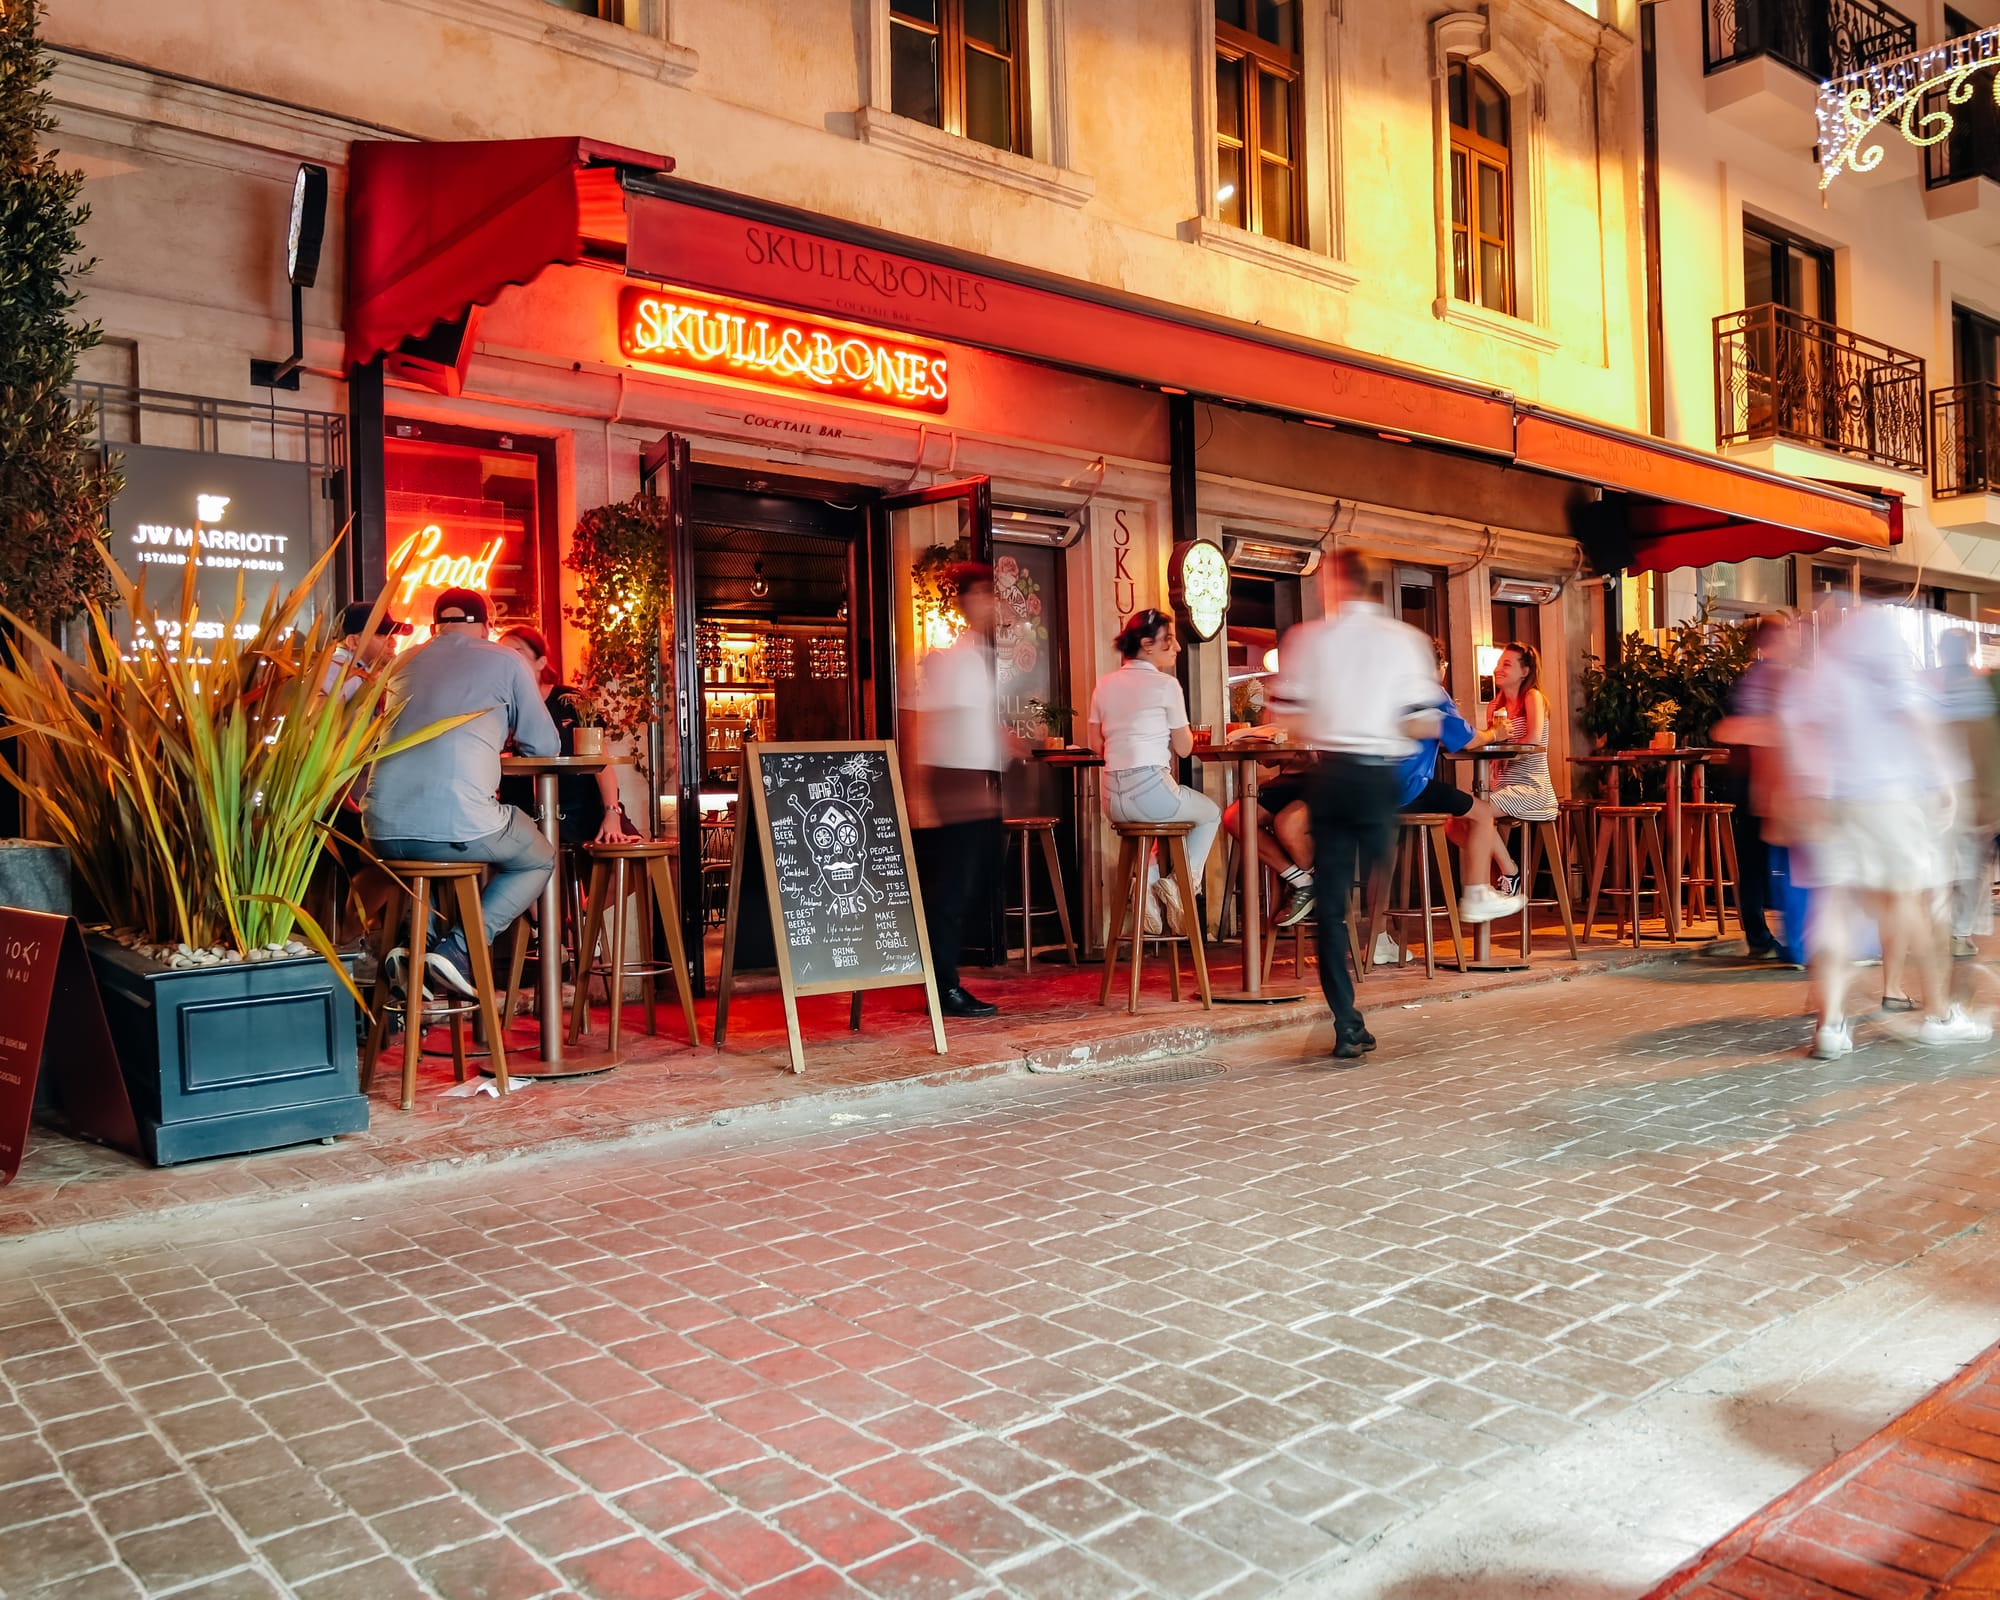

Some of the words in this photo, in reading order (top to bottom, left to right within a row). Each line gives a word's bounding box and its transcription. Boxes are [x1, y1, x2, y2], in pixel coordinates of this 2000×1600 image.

[746, 227, 987, 312] SKULL&BONES
[635, 299, 948, 400] SKULL&BONES
[818, 426, 842, 438] BAR
[132, 524, 172, 545] JW
[138, 552, 203, 567] ISTANBL
[775, 830, 794, 841] BEER
[870, 845, 894, 855] PEOPLE
[796, 907, 815, 919] BEST
[874, 910, 897, 921] MAKE
[788, 919, 806, 929] BEER
[876, 920, 898, 930] MINE
[797, 926, 816, 936] OPEN
[790, 935, 813, 946] BEER
[832, 946, 855, 956] DRINK
[842, 954, 859, 967] BEER
[6, 968, 30, 982] NAU
